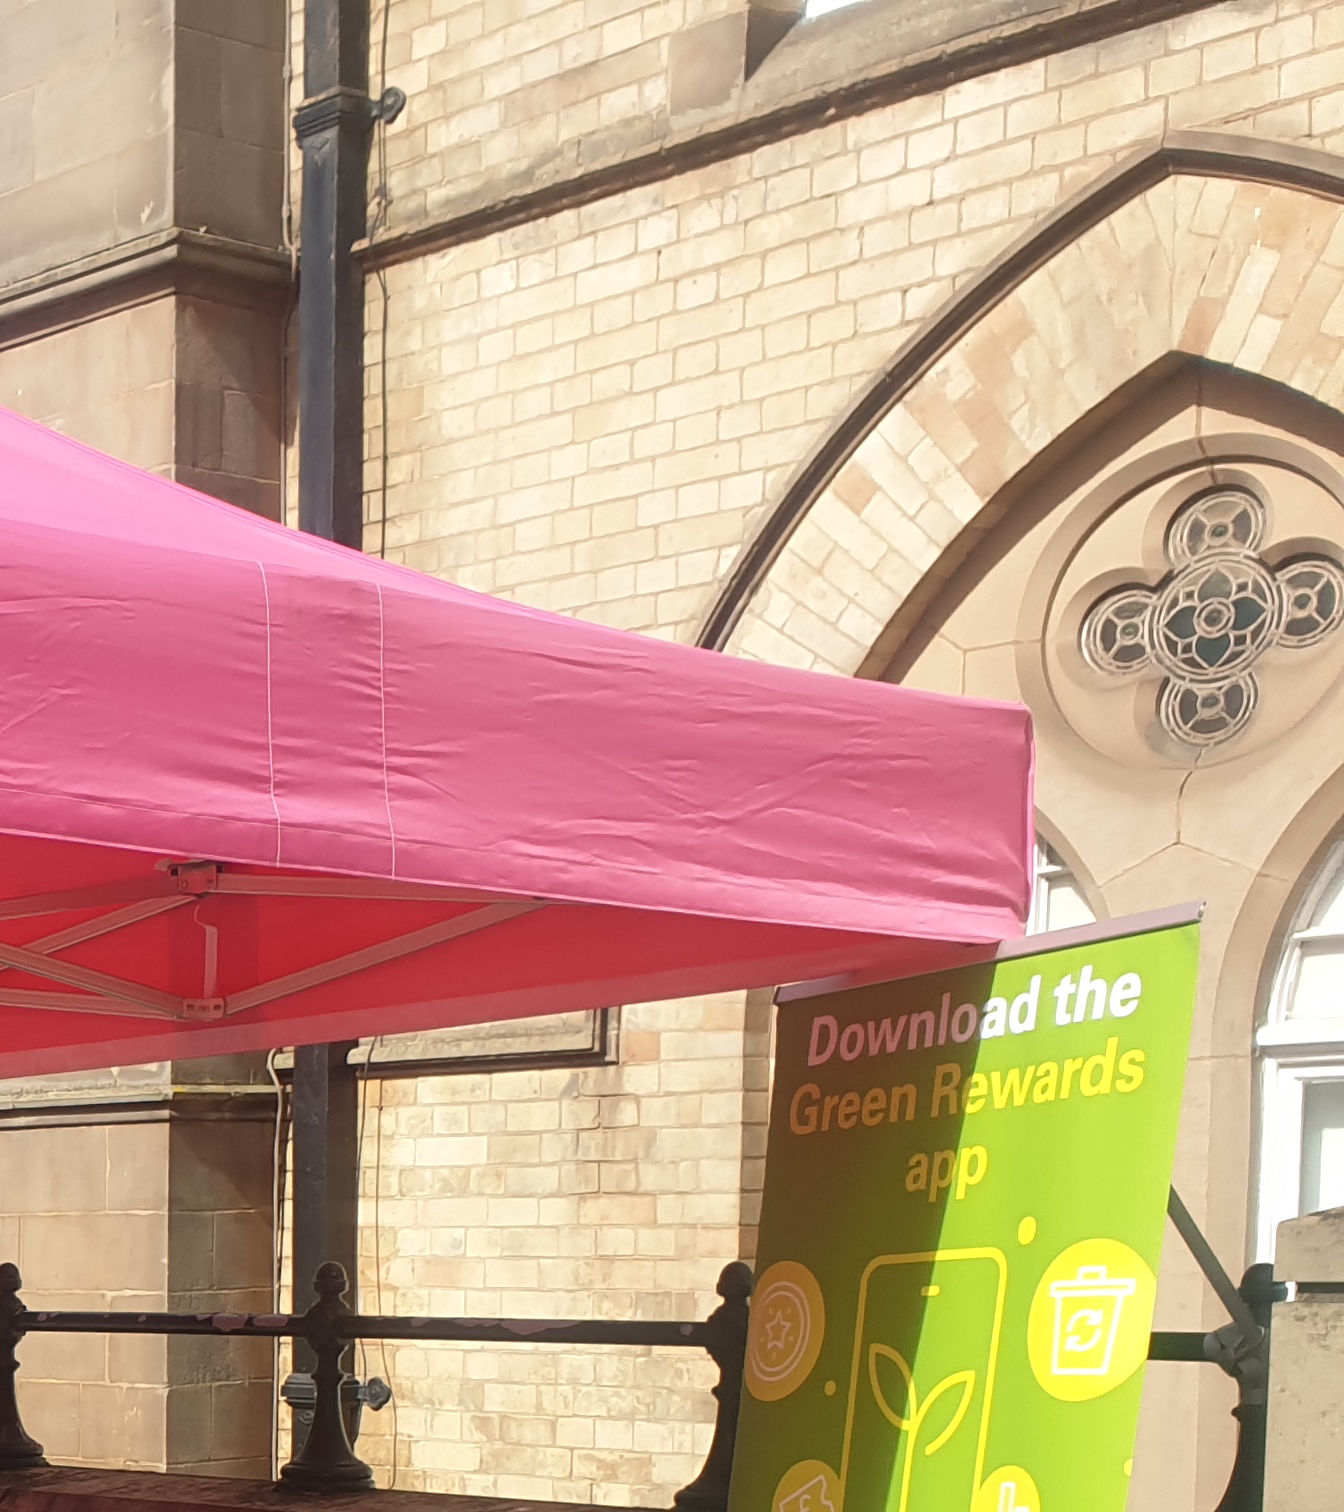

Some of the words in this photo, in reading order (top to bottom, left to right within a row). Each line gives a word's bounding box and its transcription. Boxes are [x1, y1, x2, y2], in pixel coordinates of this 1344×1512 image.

[807, 974, 1042, 1067] Download
[1054, 964, 1141, 1027] the
[789, 1082, 918, 1136] Green
[930, 1037, 1145, 1118] Rewards
[905, 1144, 988, 1203] app
